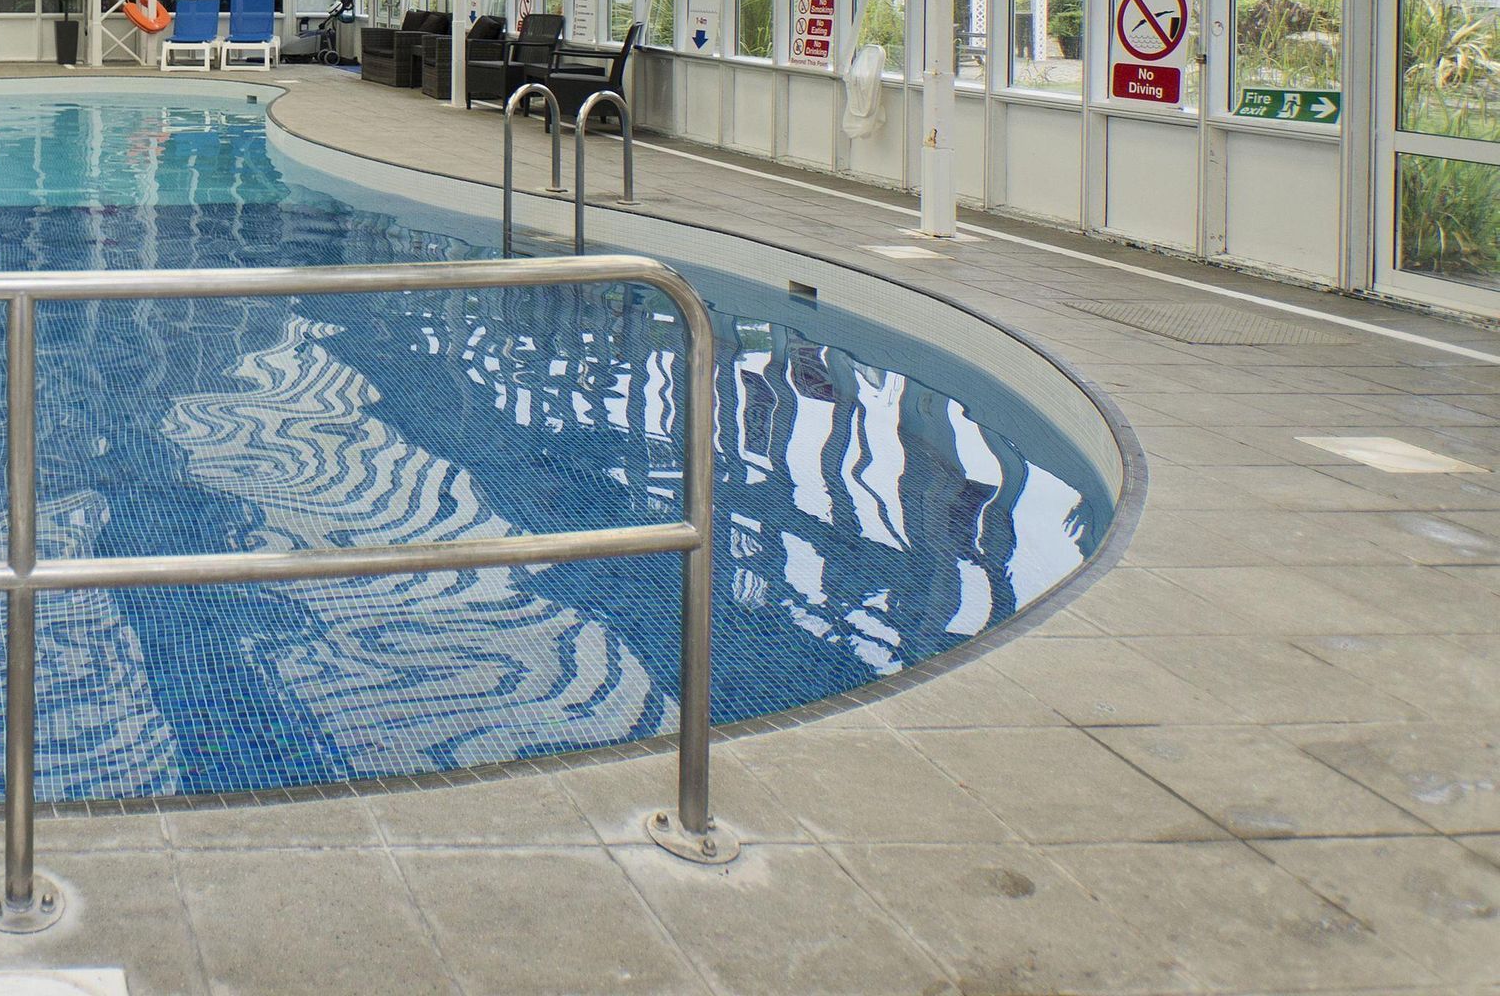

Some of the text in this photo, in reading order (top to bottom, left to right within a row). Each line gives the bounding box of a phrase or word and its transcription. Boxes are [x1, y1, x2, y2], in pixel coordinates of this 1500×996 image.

[811, 5, 834, 15] Smoking
[811, 26, 828, 36] Eating
[805, 47, 828, 58] Drinking
[1138, 68, 1155, 81] No
[1128, 81, 1164, 99] Diving
[1245, 92, 1272, 104] Fire
[1240, 106, 1267, 116] exit
